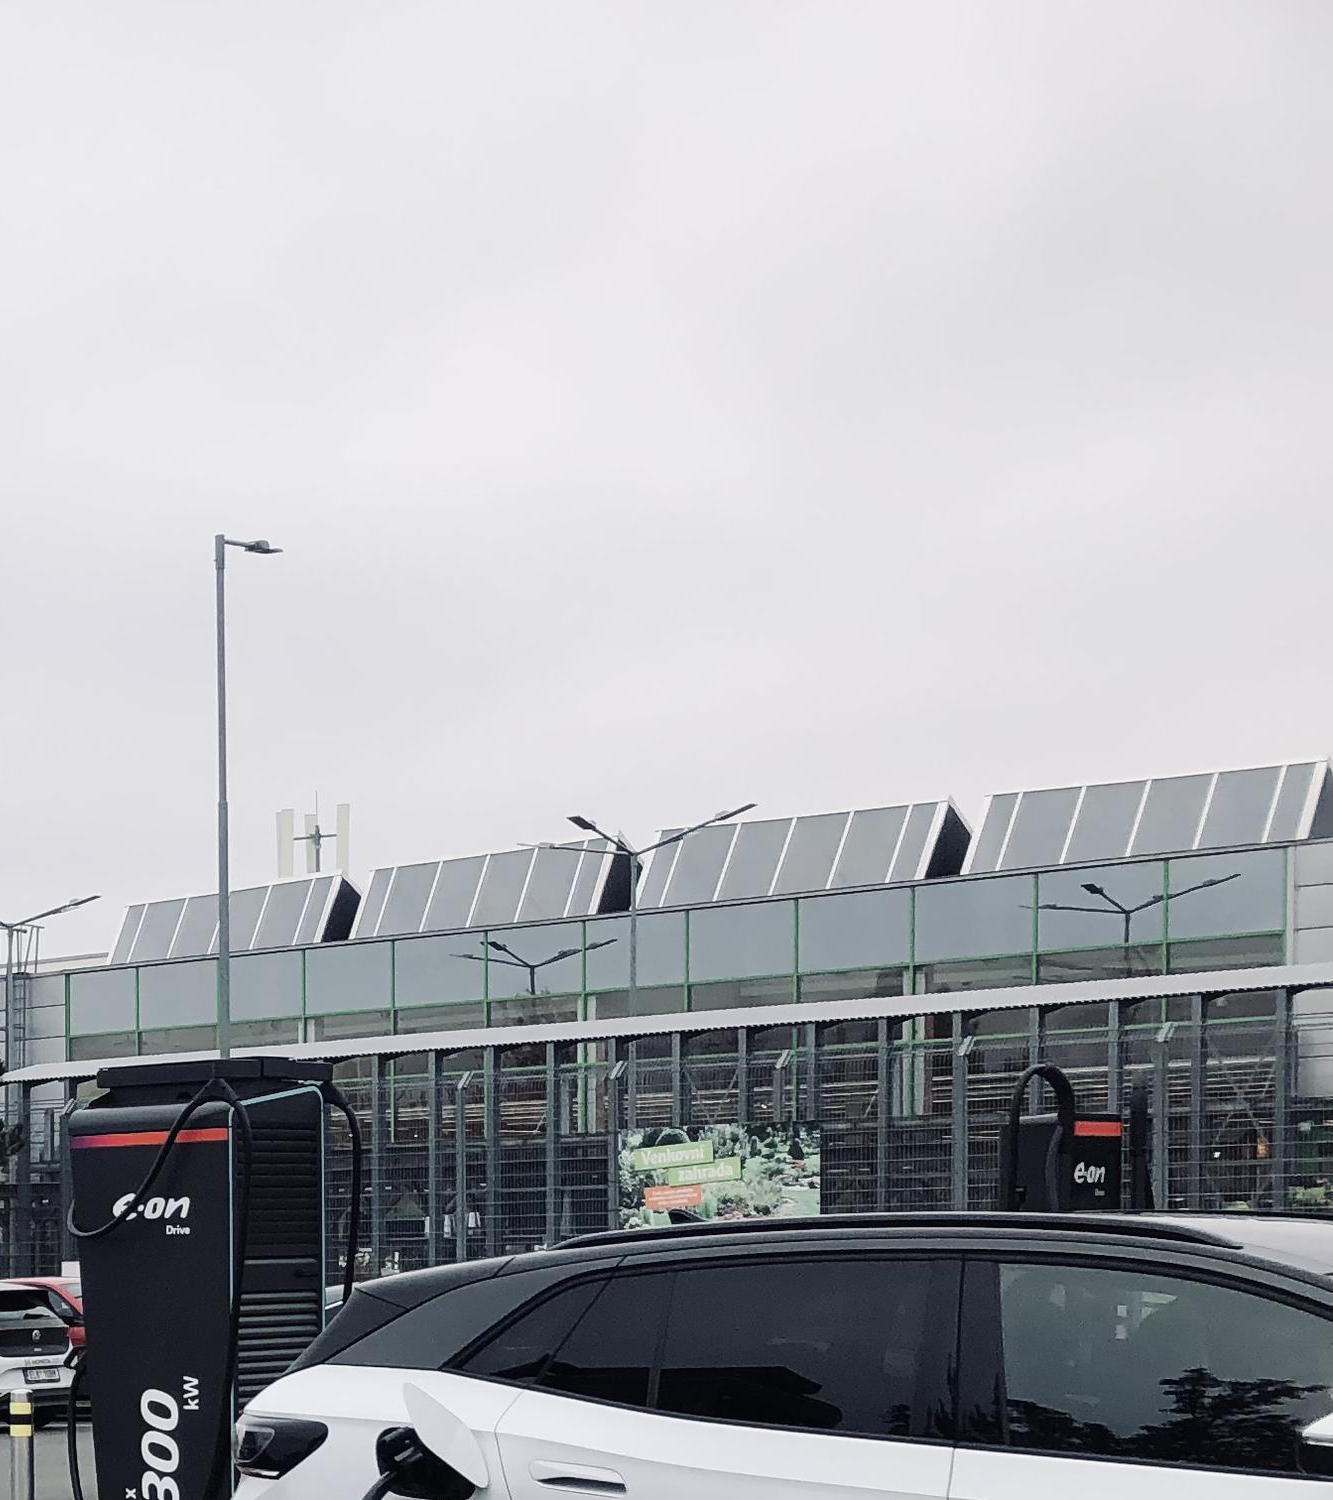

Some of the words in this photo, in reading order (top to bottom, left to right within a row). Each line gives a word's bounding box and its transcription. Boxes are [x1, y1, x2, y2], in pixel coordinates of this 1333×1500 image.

[641, 1146, 704, 1166] Venkovní
[678, 1161, 733, 1181] zahrada
[165, 1224, 191, 1235] Drive
[182, 1375, 200, 1411] kW
